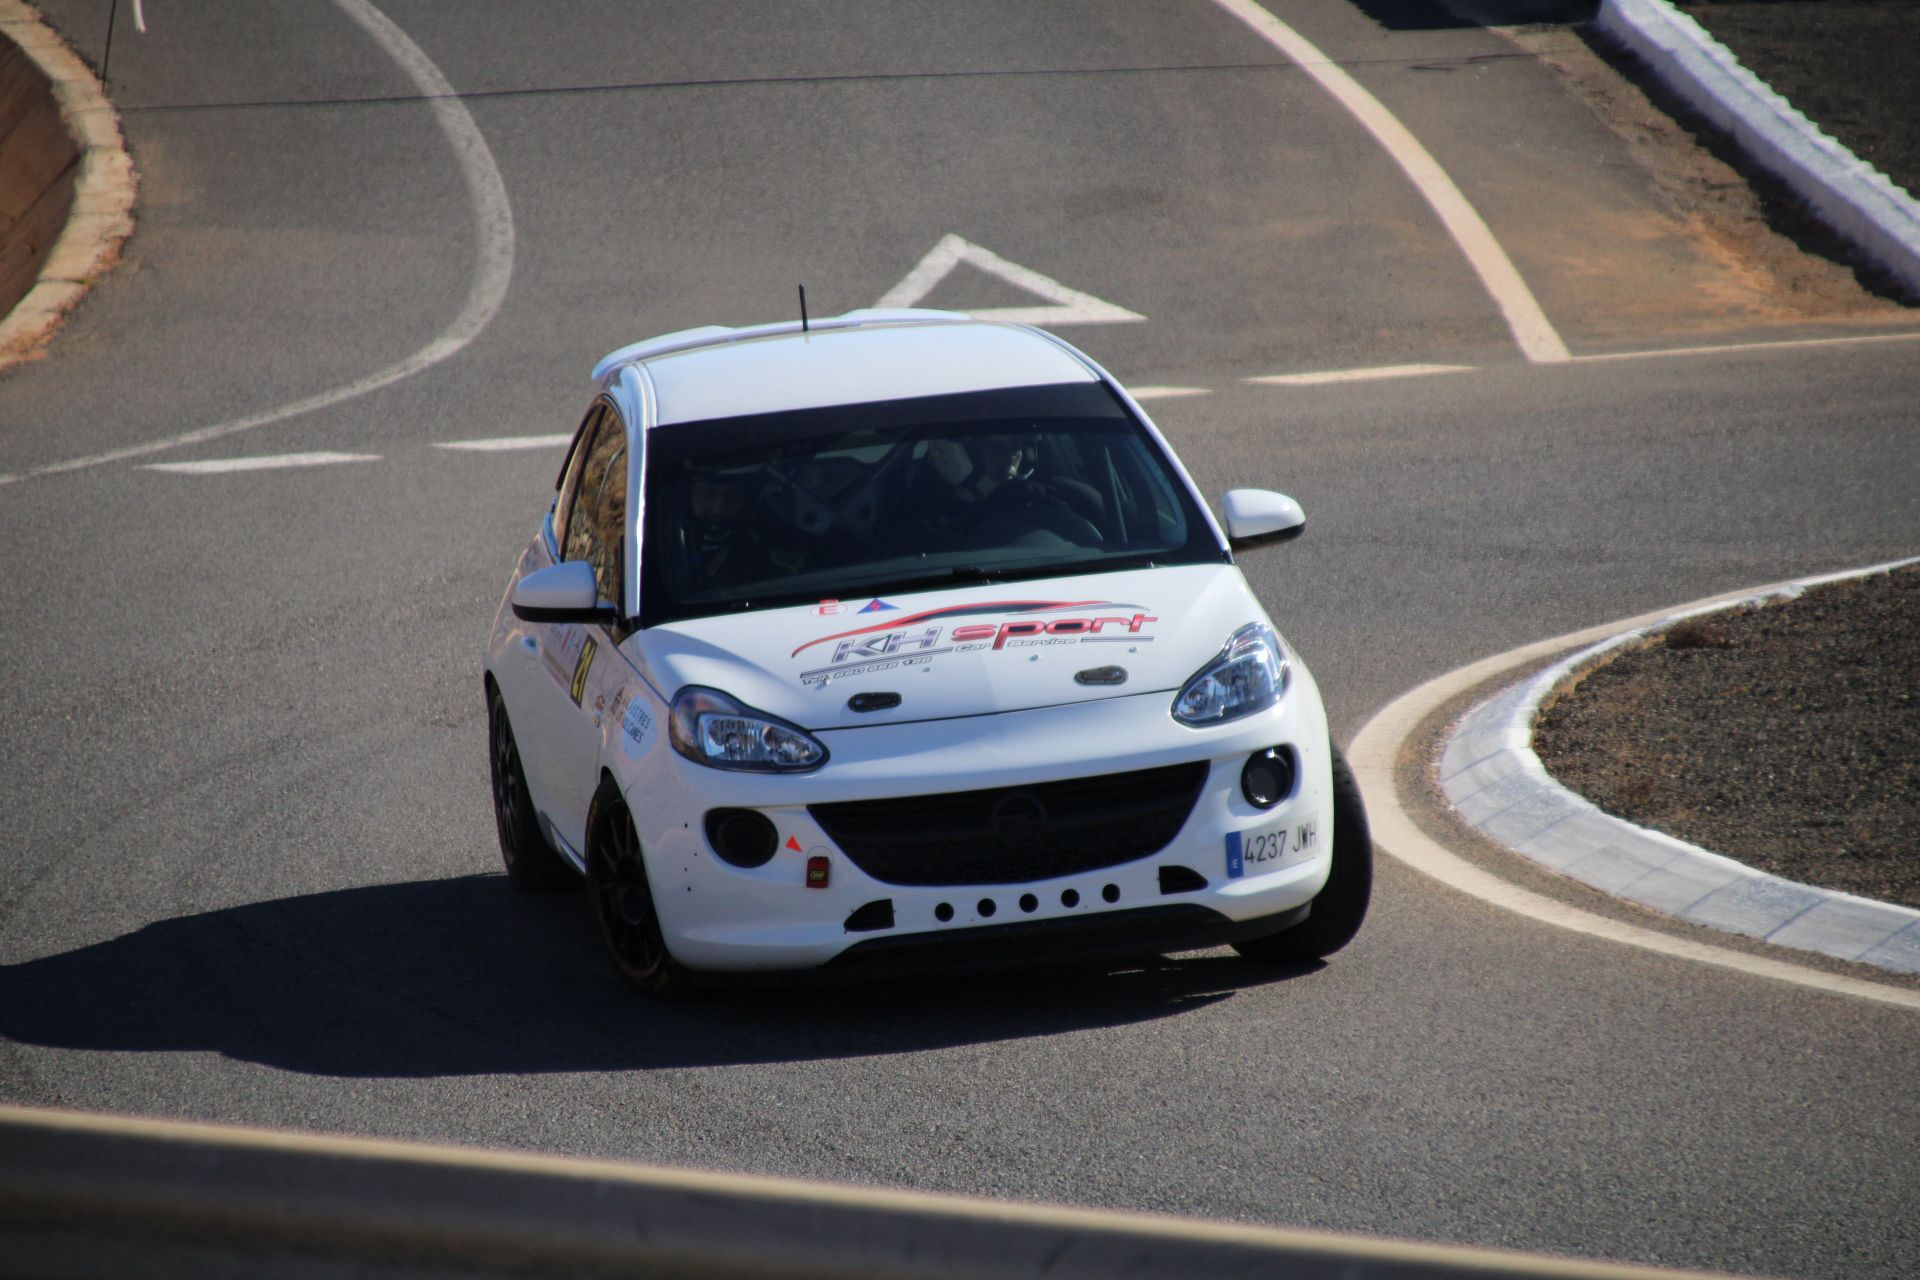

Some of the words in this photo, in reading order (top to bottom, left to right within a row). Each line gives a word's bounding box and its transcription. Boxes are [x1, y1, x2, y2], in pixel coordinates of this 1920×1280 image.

[831, 626, 943, 663] KH
[950, 613, 1159, 650] sport
[955, 642, 992, 653] Car
[1007, 637, 1077, 648] Service
[1244, 829, 1287, 864] 4237
[1292, 821, 1316, 852] JWH
